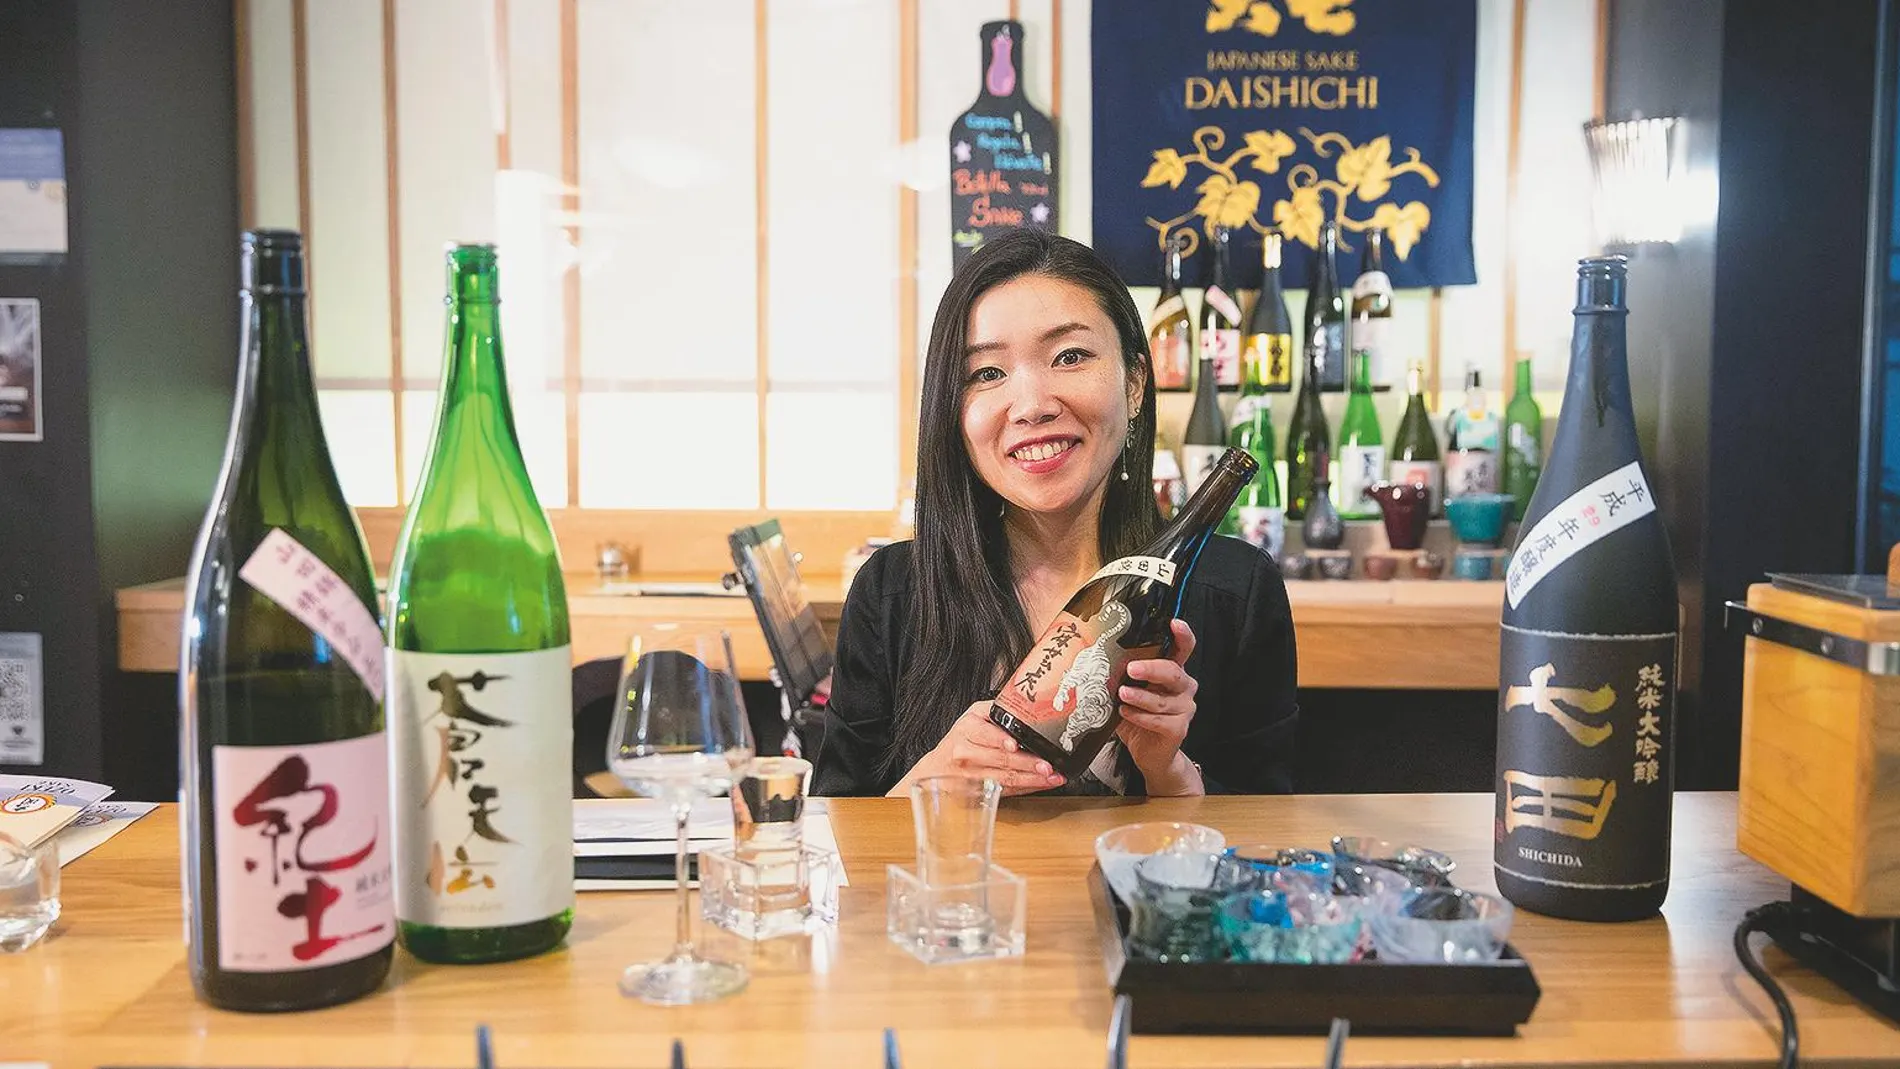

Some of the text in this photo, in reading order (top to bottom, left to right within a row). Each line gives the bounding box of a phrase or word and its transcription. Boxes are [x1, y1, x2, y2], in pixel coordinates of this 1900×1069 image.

[1184, 76, 1378, 109] DAISHICHI
[1207, 50, 1358, 70] JAPANESE SAKE
[1505, 662, 1617, 840] 七田
[1633, 663, 1666, 784] 純米大吟醸
[233, 753, 383, 961] 紀土
[1518, 846, 1583, 868] SHICHIDA
